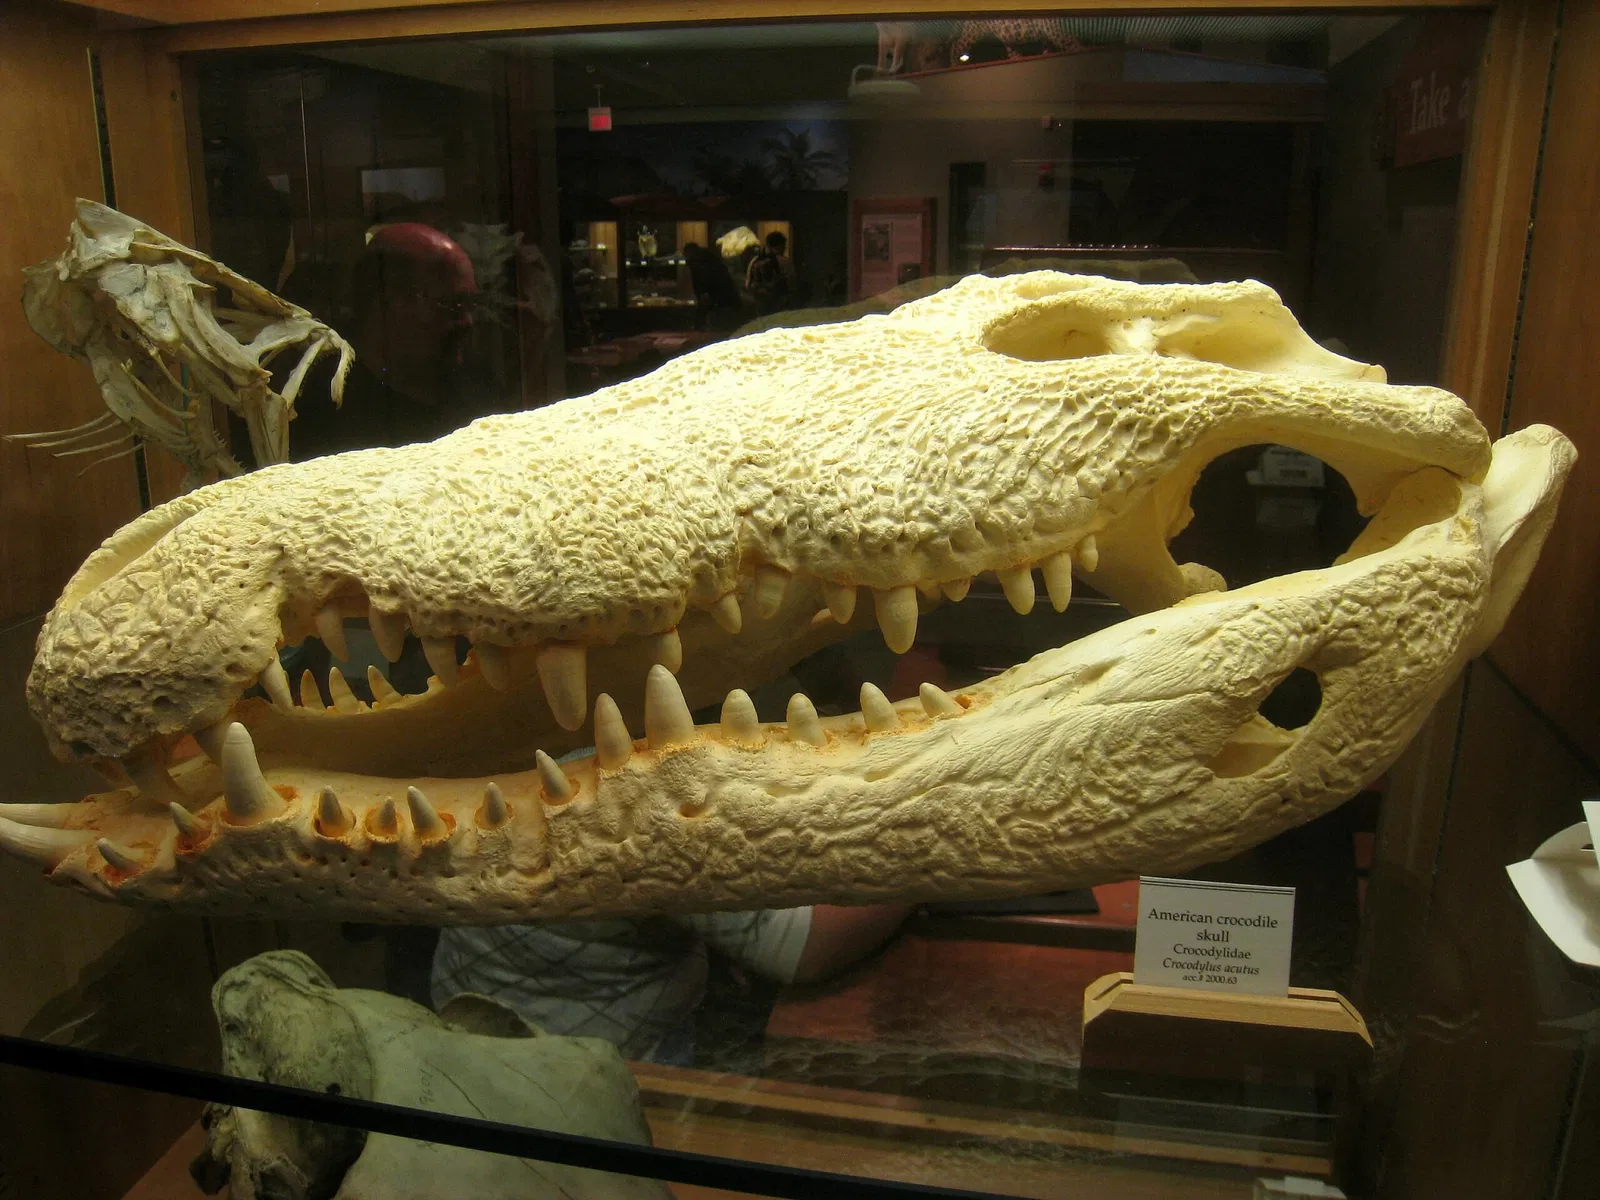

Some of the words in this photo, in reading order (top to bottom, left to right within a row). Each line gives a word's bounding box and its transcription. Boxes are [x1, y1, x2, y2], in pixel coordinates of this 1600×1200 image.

[1408, 70, 1450, 135] Take
[1148, 908, 1213, 924] American
[1217, 915, 1278, 929] crocodile
[1196, 929, 1230, 943] skull
[1173, 943, 1252, 960] Crocodylidae
[1162, 957, 1222, 974] Crocodylus
[1224, 965, 1260, 975] acutus
[1206, 975, 1238, 985] 2000.63
